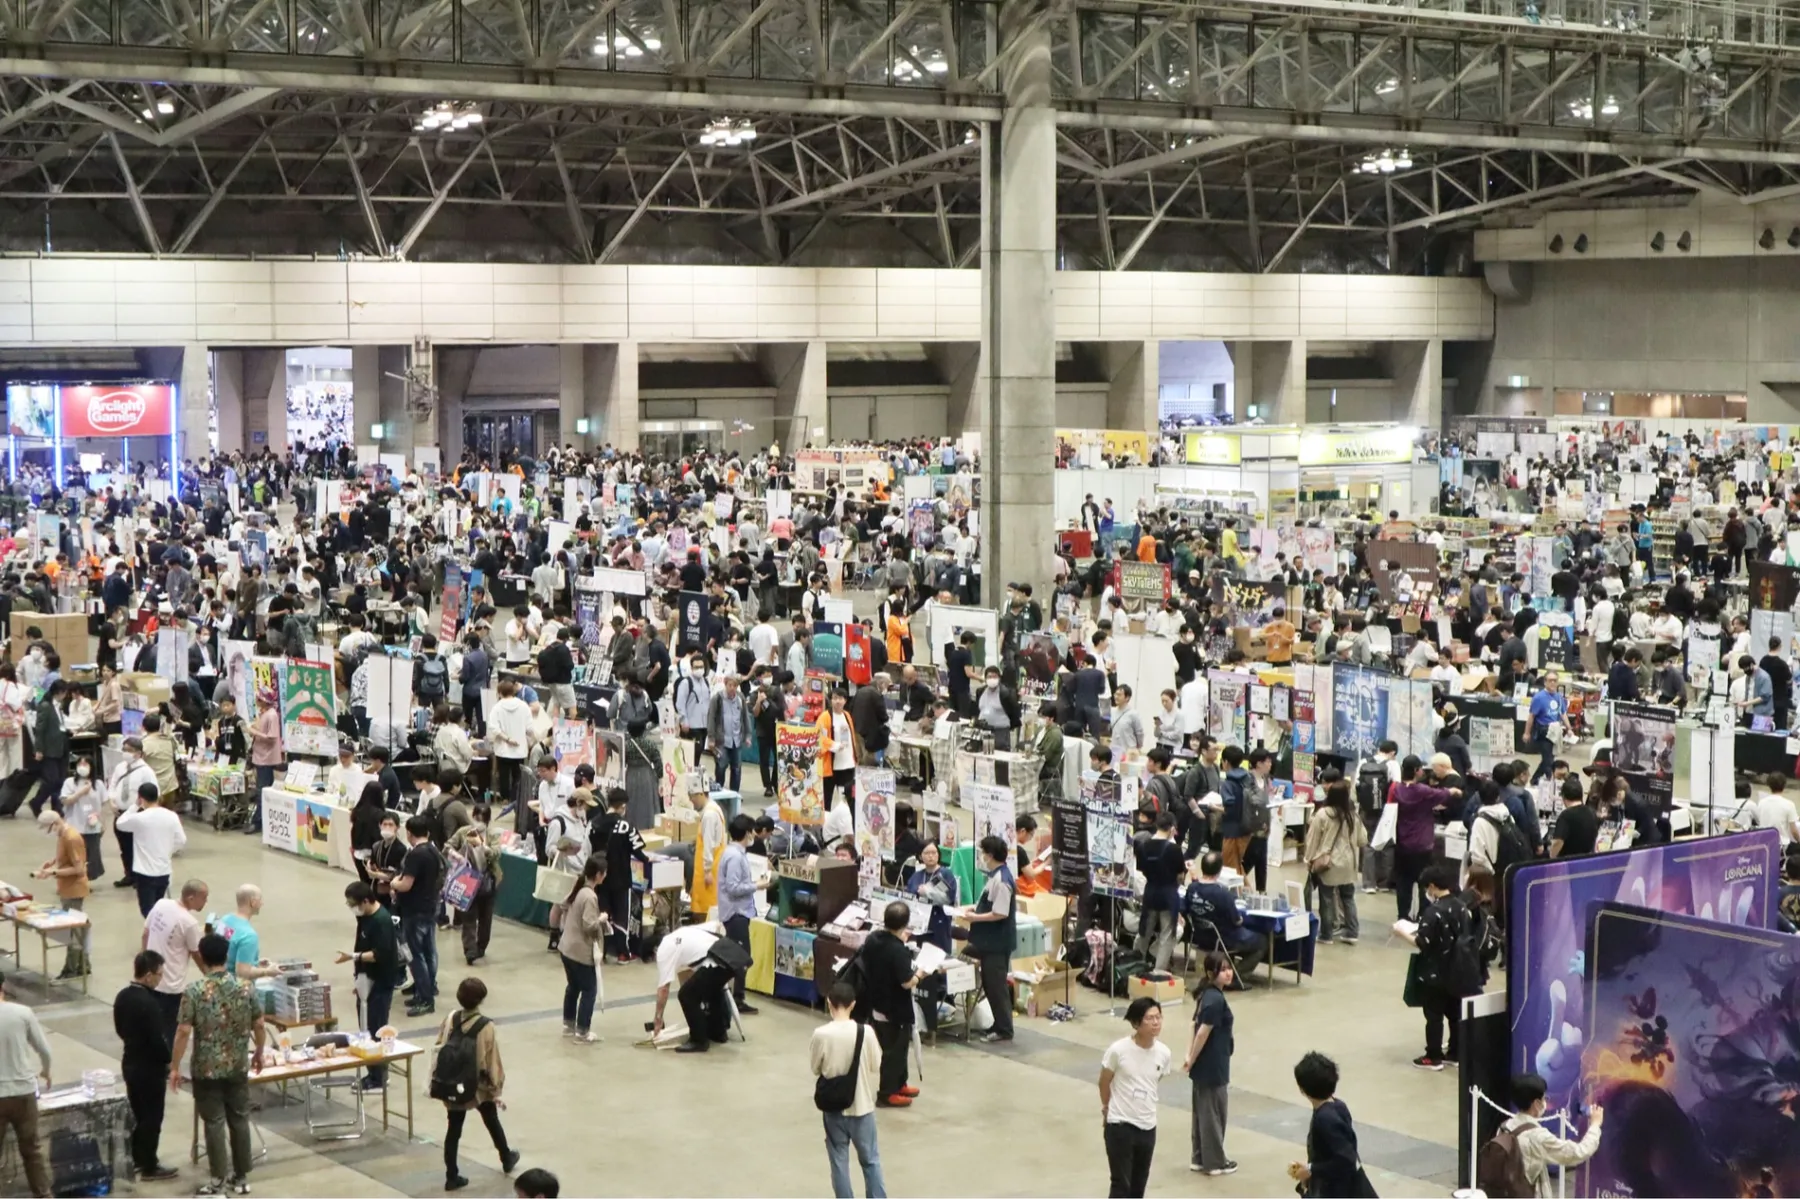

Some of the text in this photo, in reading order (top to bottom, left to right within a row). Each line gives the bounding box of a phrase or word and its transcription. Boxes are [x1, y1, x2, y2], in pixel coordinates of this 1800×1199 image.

[91, 398, 142, 414] Arclight
[92, 410, 137, 422] Games
[1126, 784, 1133, 793] R
[1724, 863, 1763, 881] LORCANA
